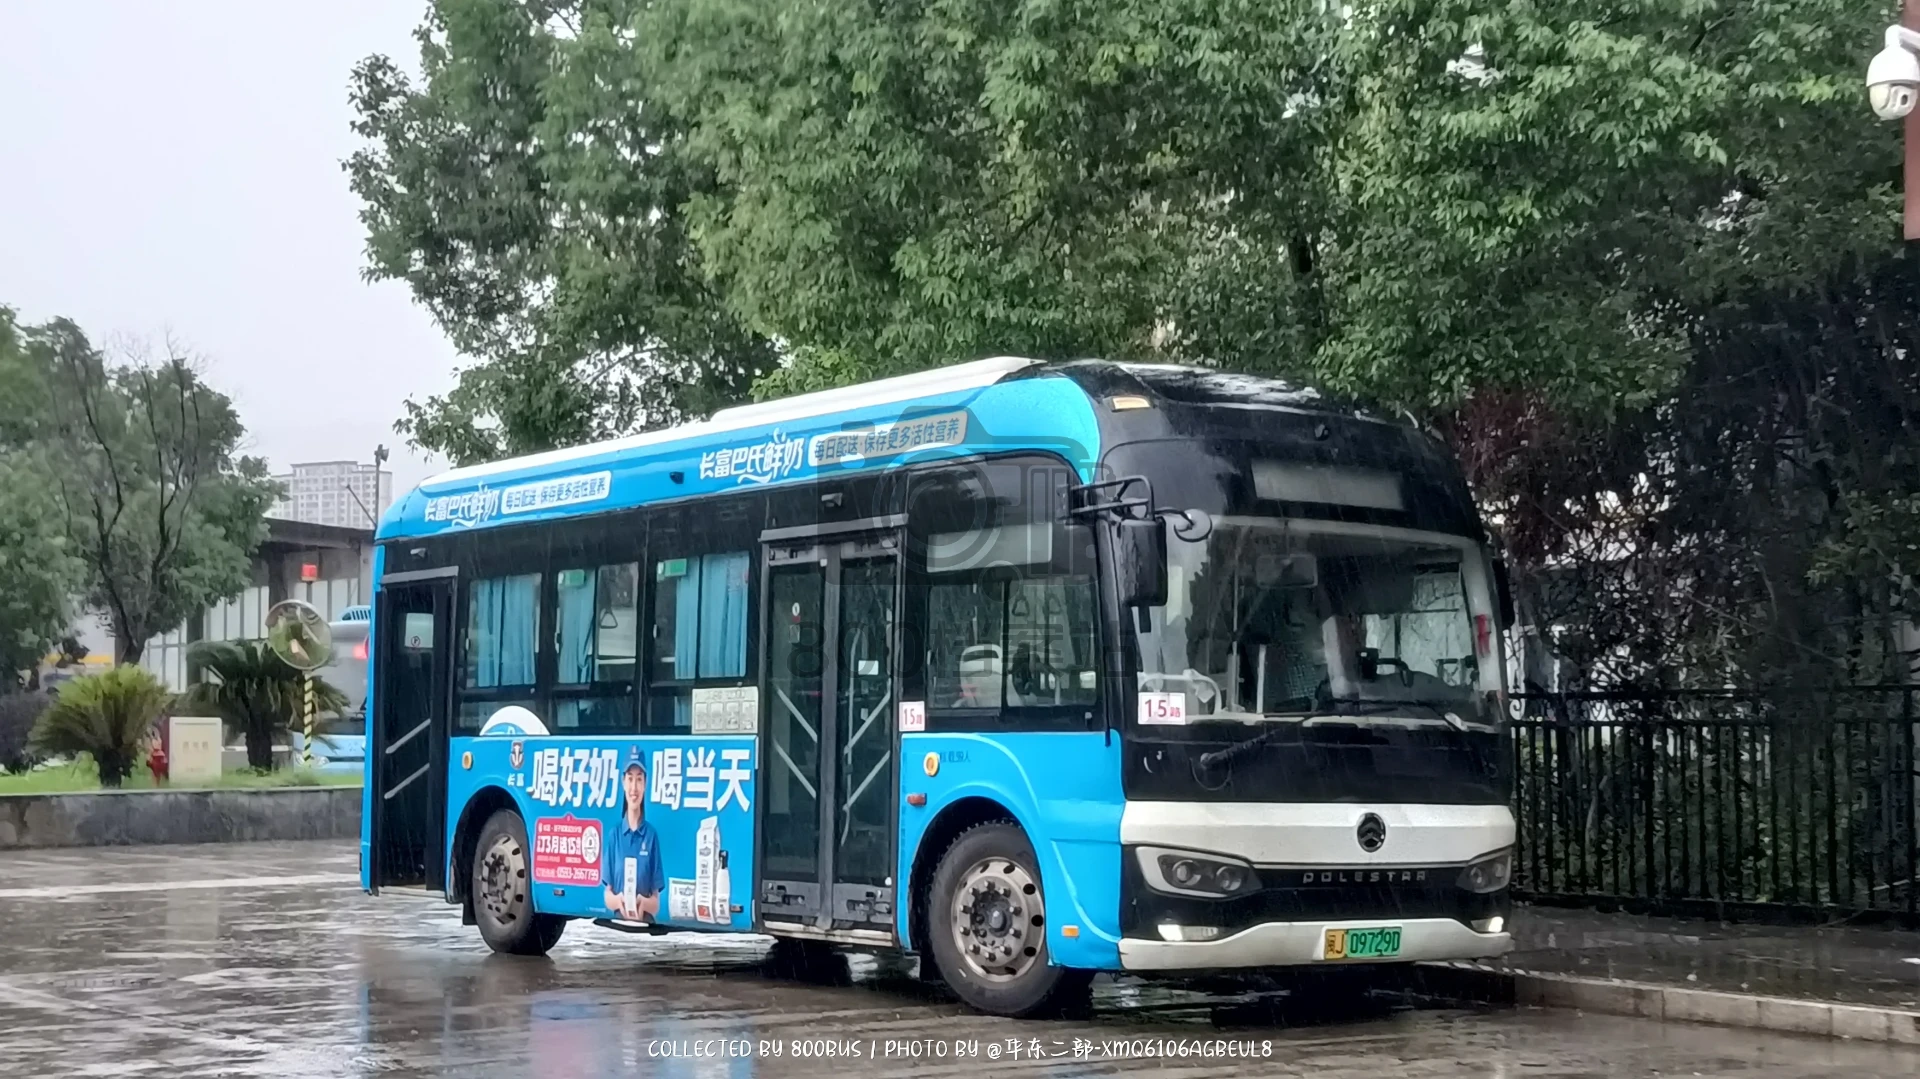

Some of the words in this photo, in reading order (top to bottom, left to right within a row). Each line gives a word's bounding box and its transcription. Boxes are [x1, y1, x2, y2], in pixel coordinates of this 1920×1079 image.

[699, 431, 804, 482] 长富巴氏鲜奶
[424, 483, 500, 526] 长富巴氏鲜奶
[531, 746, 620, 808] 喝好奶
[650, 746, 751, 812] 喝当天
[1302, 871, 1426, 884] POLESTAR
[1350, 931, 1401, 954] 09729D
